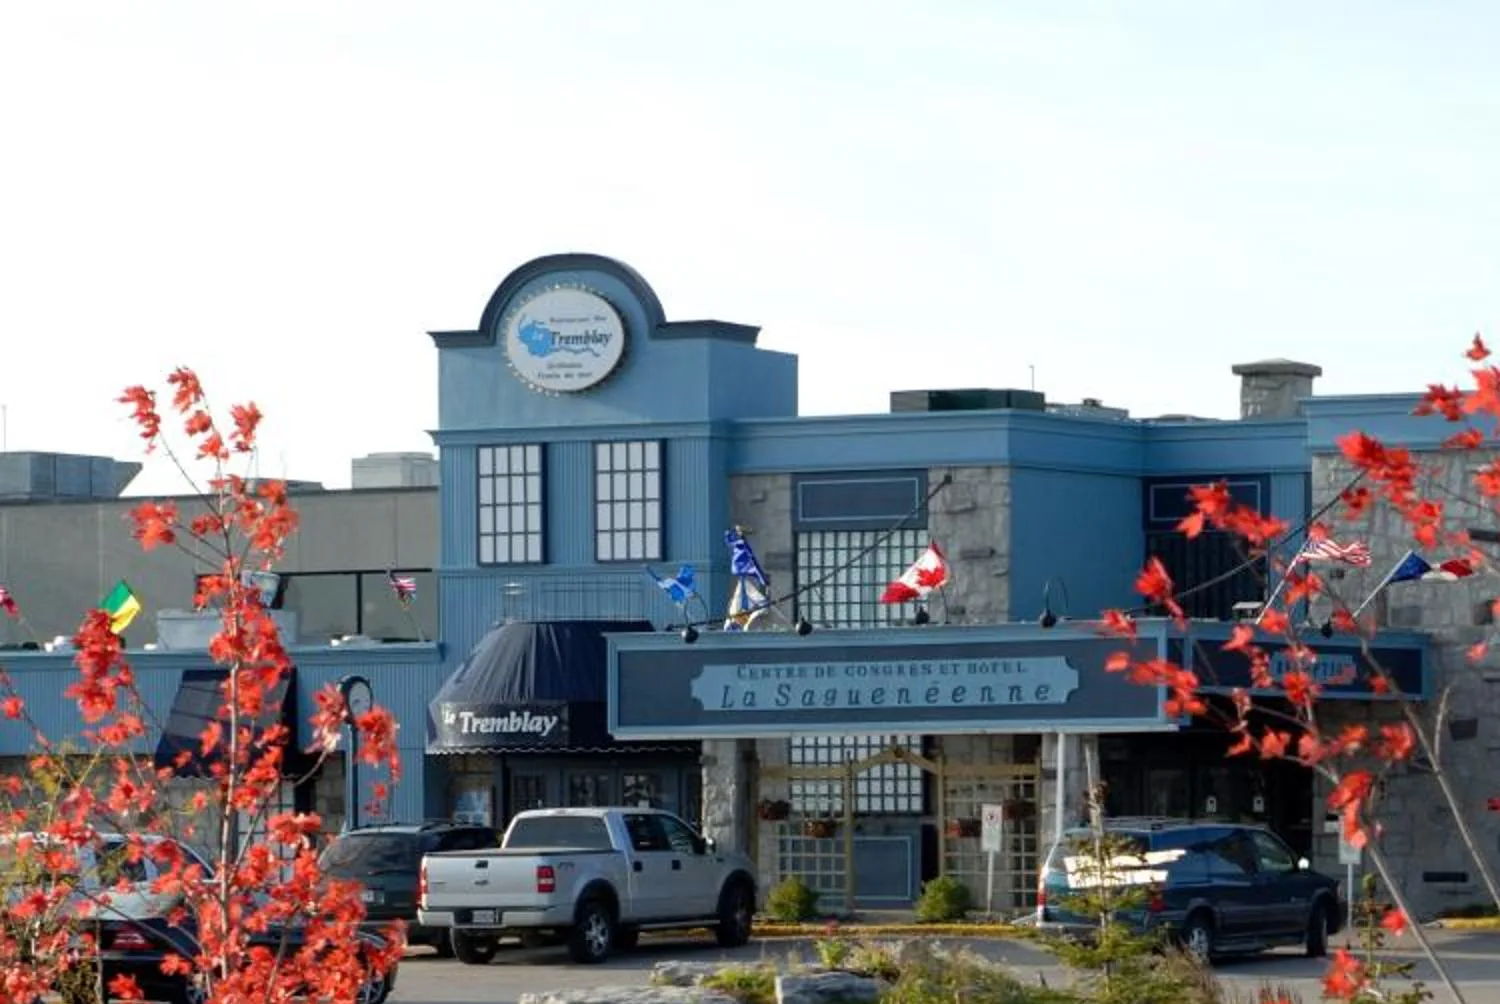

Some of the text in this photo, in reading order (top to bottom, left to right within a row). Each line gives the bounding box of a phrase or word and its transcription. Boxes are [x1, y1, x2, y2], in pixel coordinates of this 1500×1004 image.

[551, 329, 613, 348] Tremblay
[815, 664, 837, 679] DE
[939, 662, 961, 675] ET
[720, 679, 1051, 709] La Saguenéenne
[459, 711, 558, 736] Tremblay
